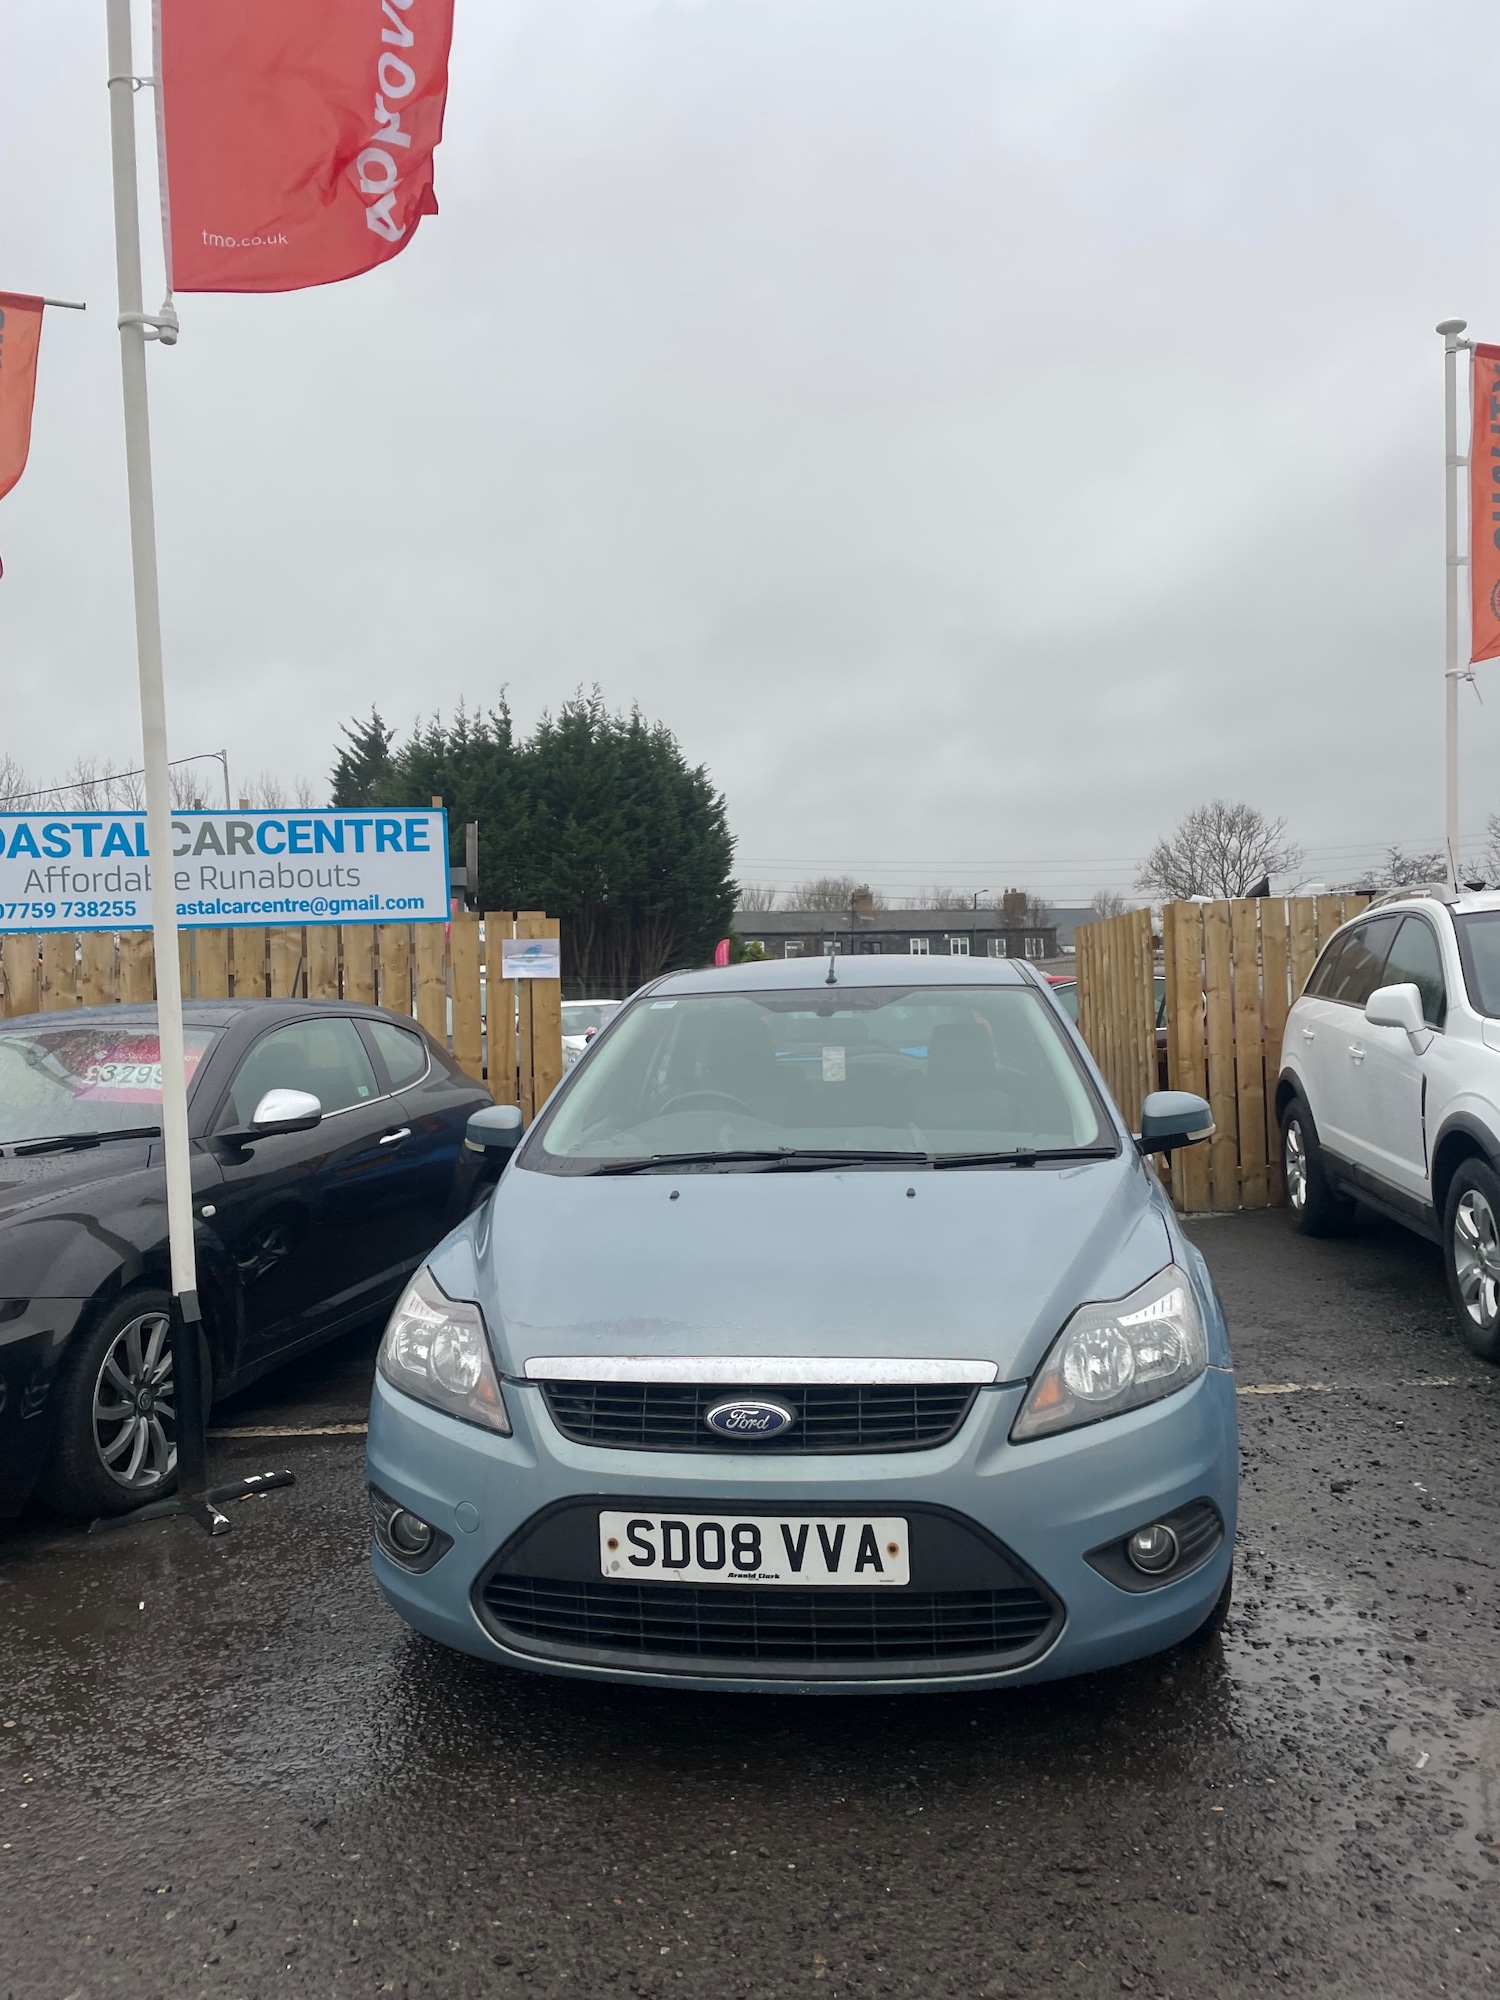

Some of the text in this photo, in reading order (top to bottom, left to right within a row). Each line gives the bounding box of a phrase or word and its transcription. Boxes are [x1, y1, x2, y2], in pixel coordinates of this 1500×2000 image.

[202, 229, 288, 247] tmo.co.uk
[24, 862, 360, 893] Affordabe Runabouts
[61, 901, 136, 918] 738255
[176, 895, 424, 915] astalcarcentre@gmail.com
[726, 1409, 770, 1431] Ford
[626, 1519, 885, 1573] SD08 VVA
